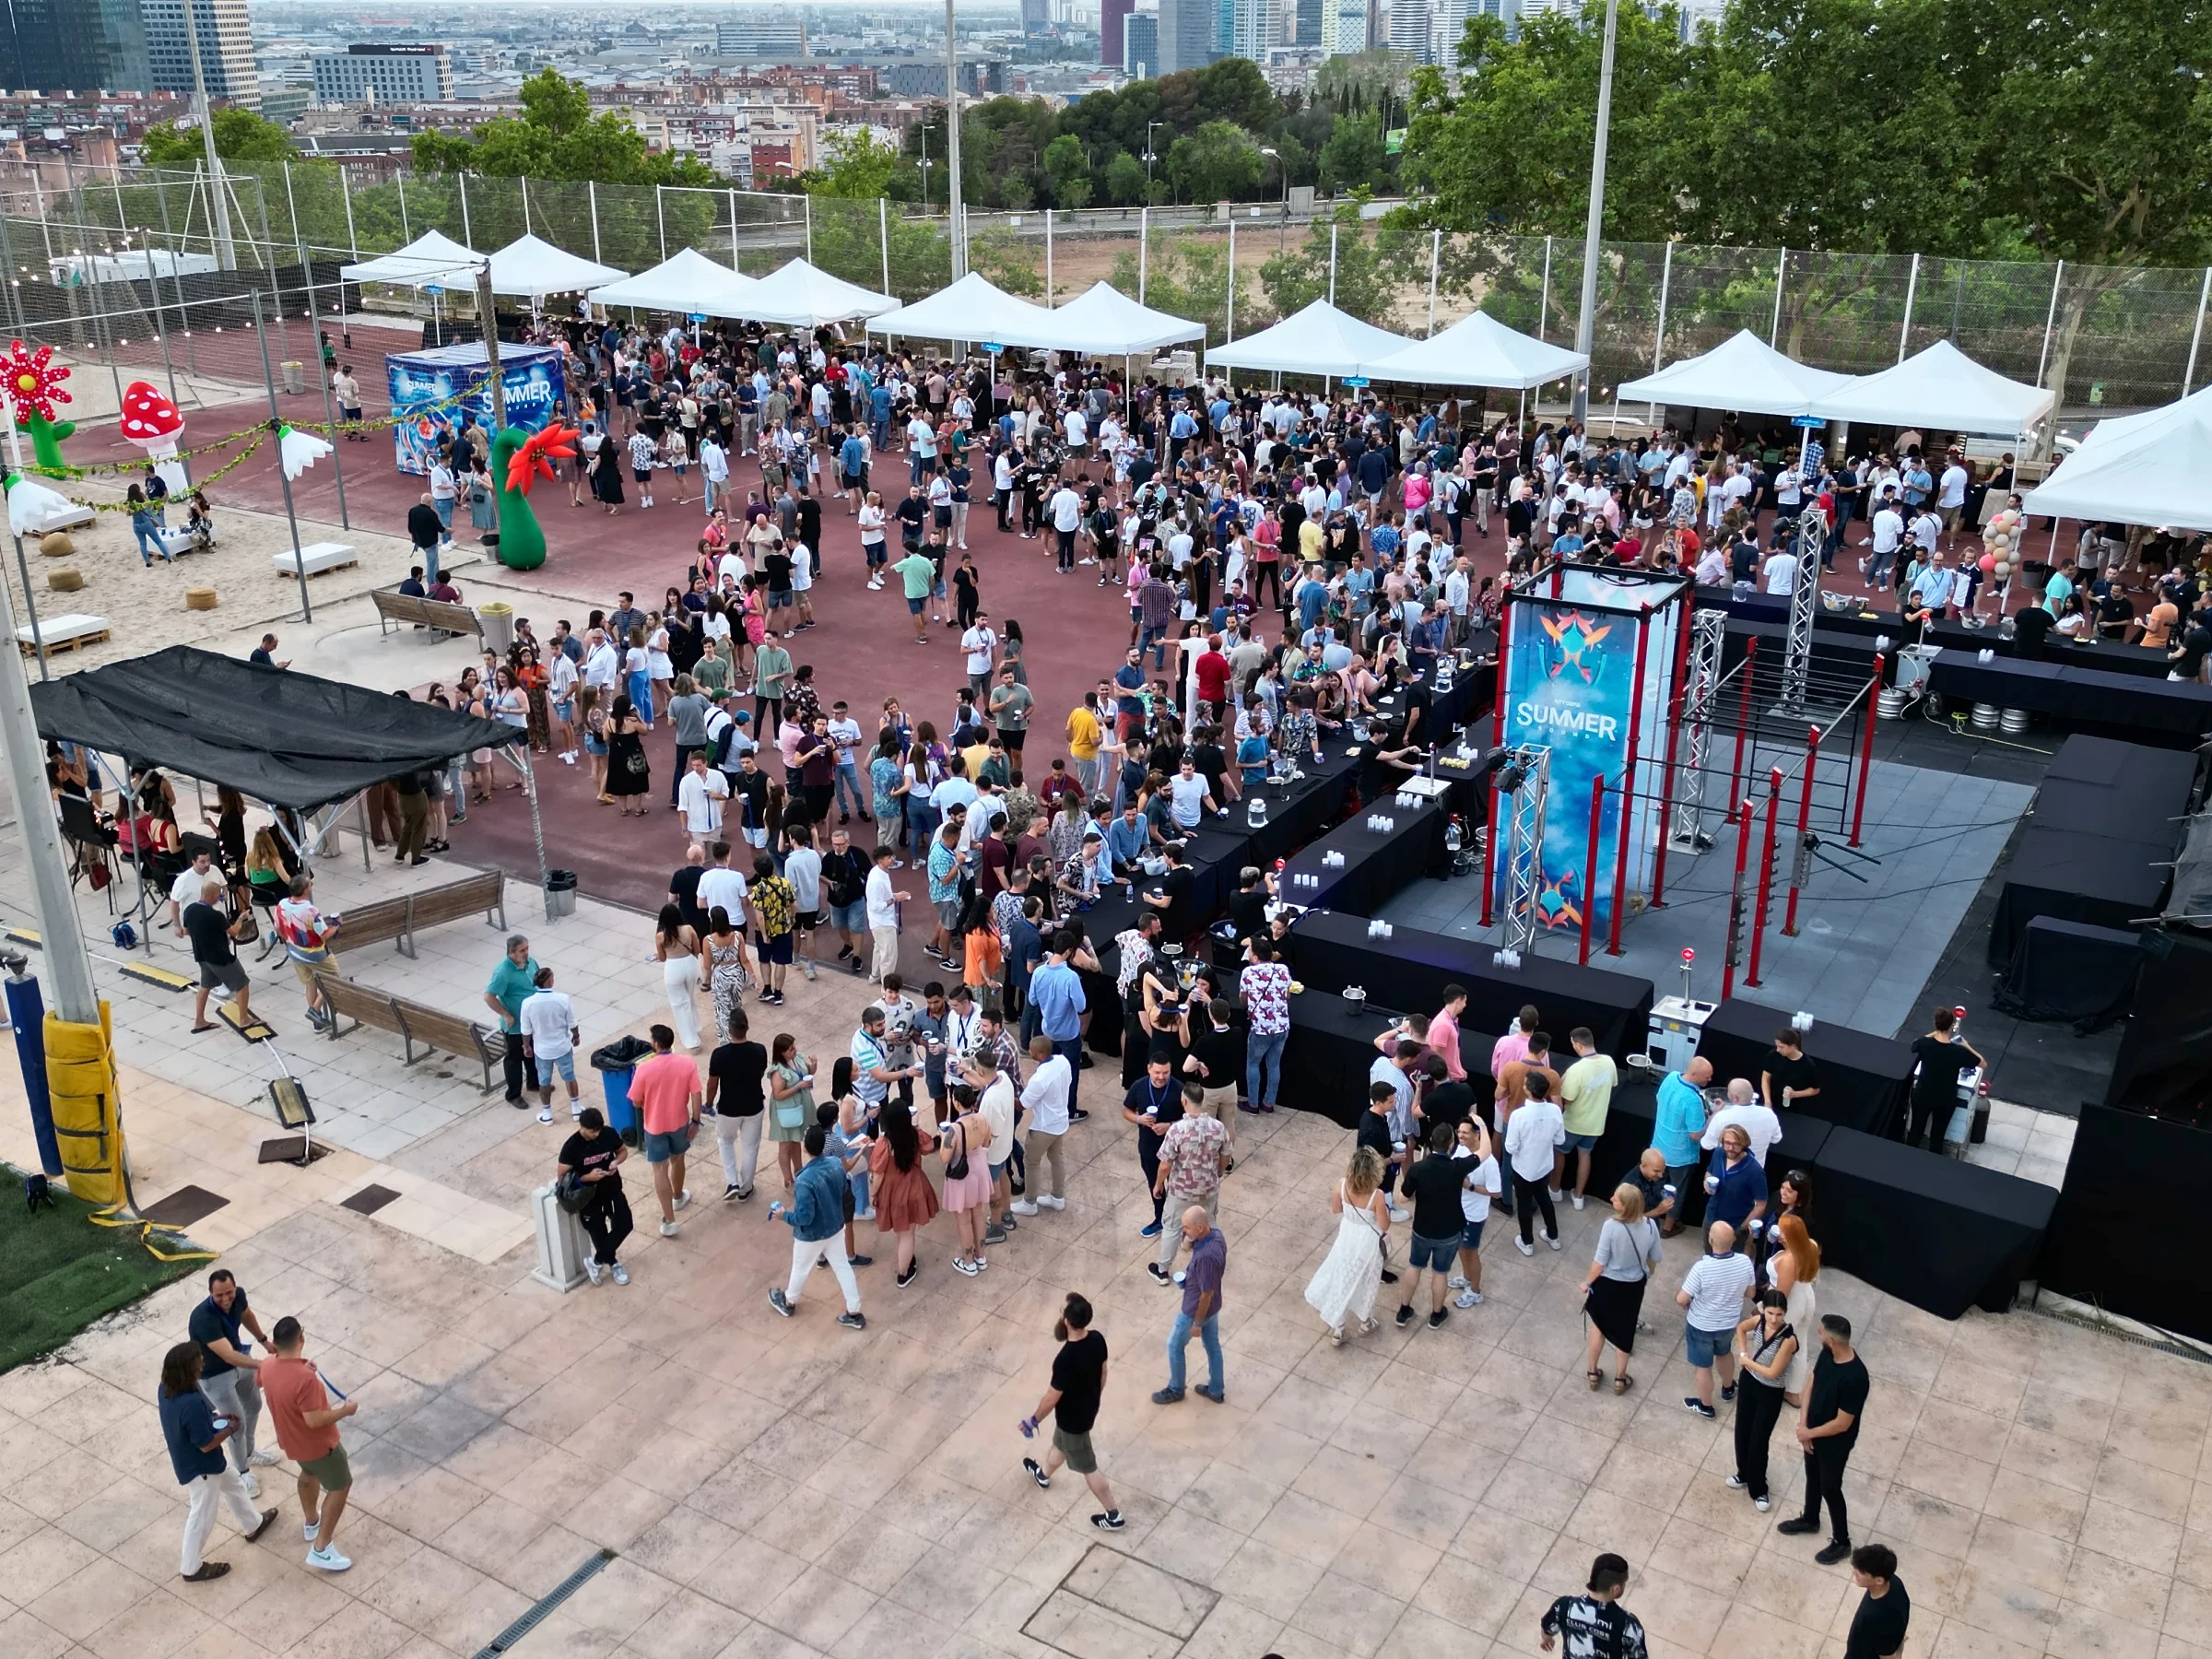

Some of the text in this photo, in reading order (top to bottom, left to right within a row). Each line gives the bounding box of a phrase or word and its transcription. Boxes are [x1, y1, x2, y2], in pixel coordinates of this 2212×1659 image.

[482, 380, 552, 414] SMMER
[1516, 702, 1618, 741] SUMMER
[1537, 725, 1590, 739] SOUND
